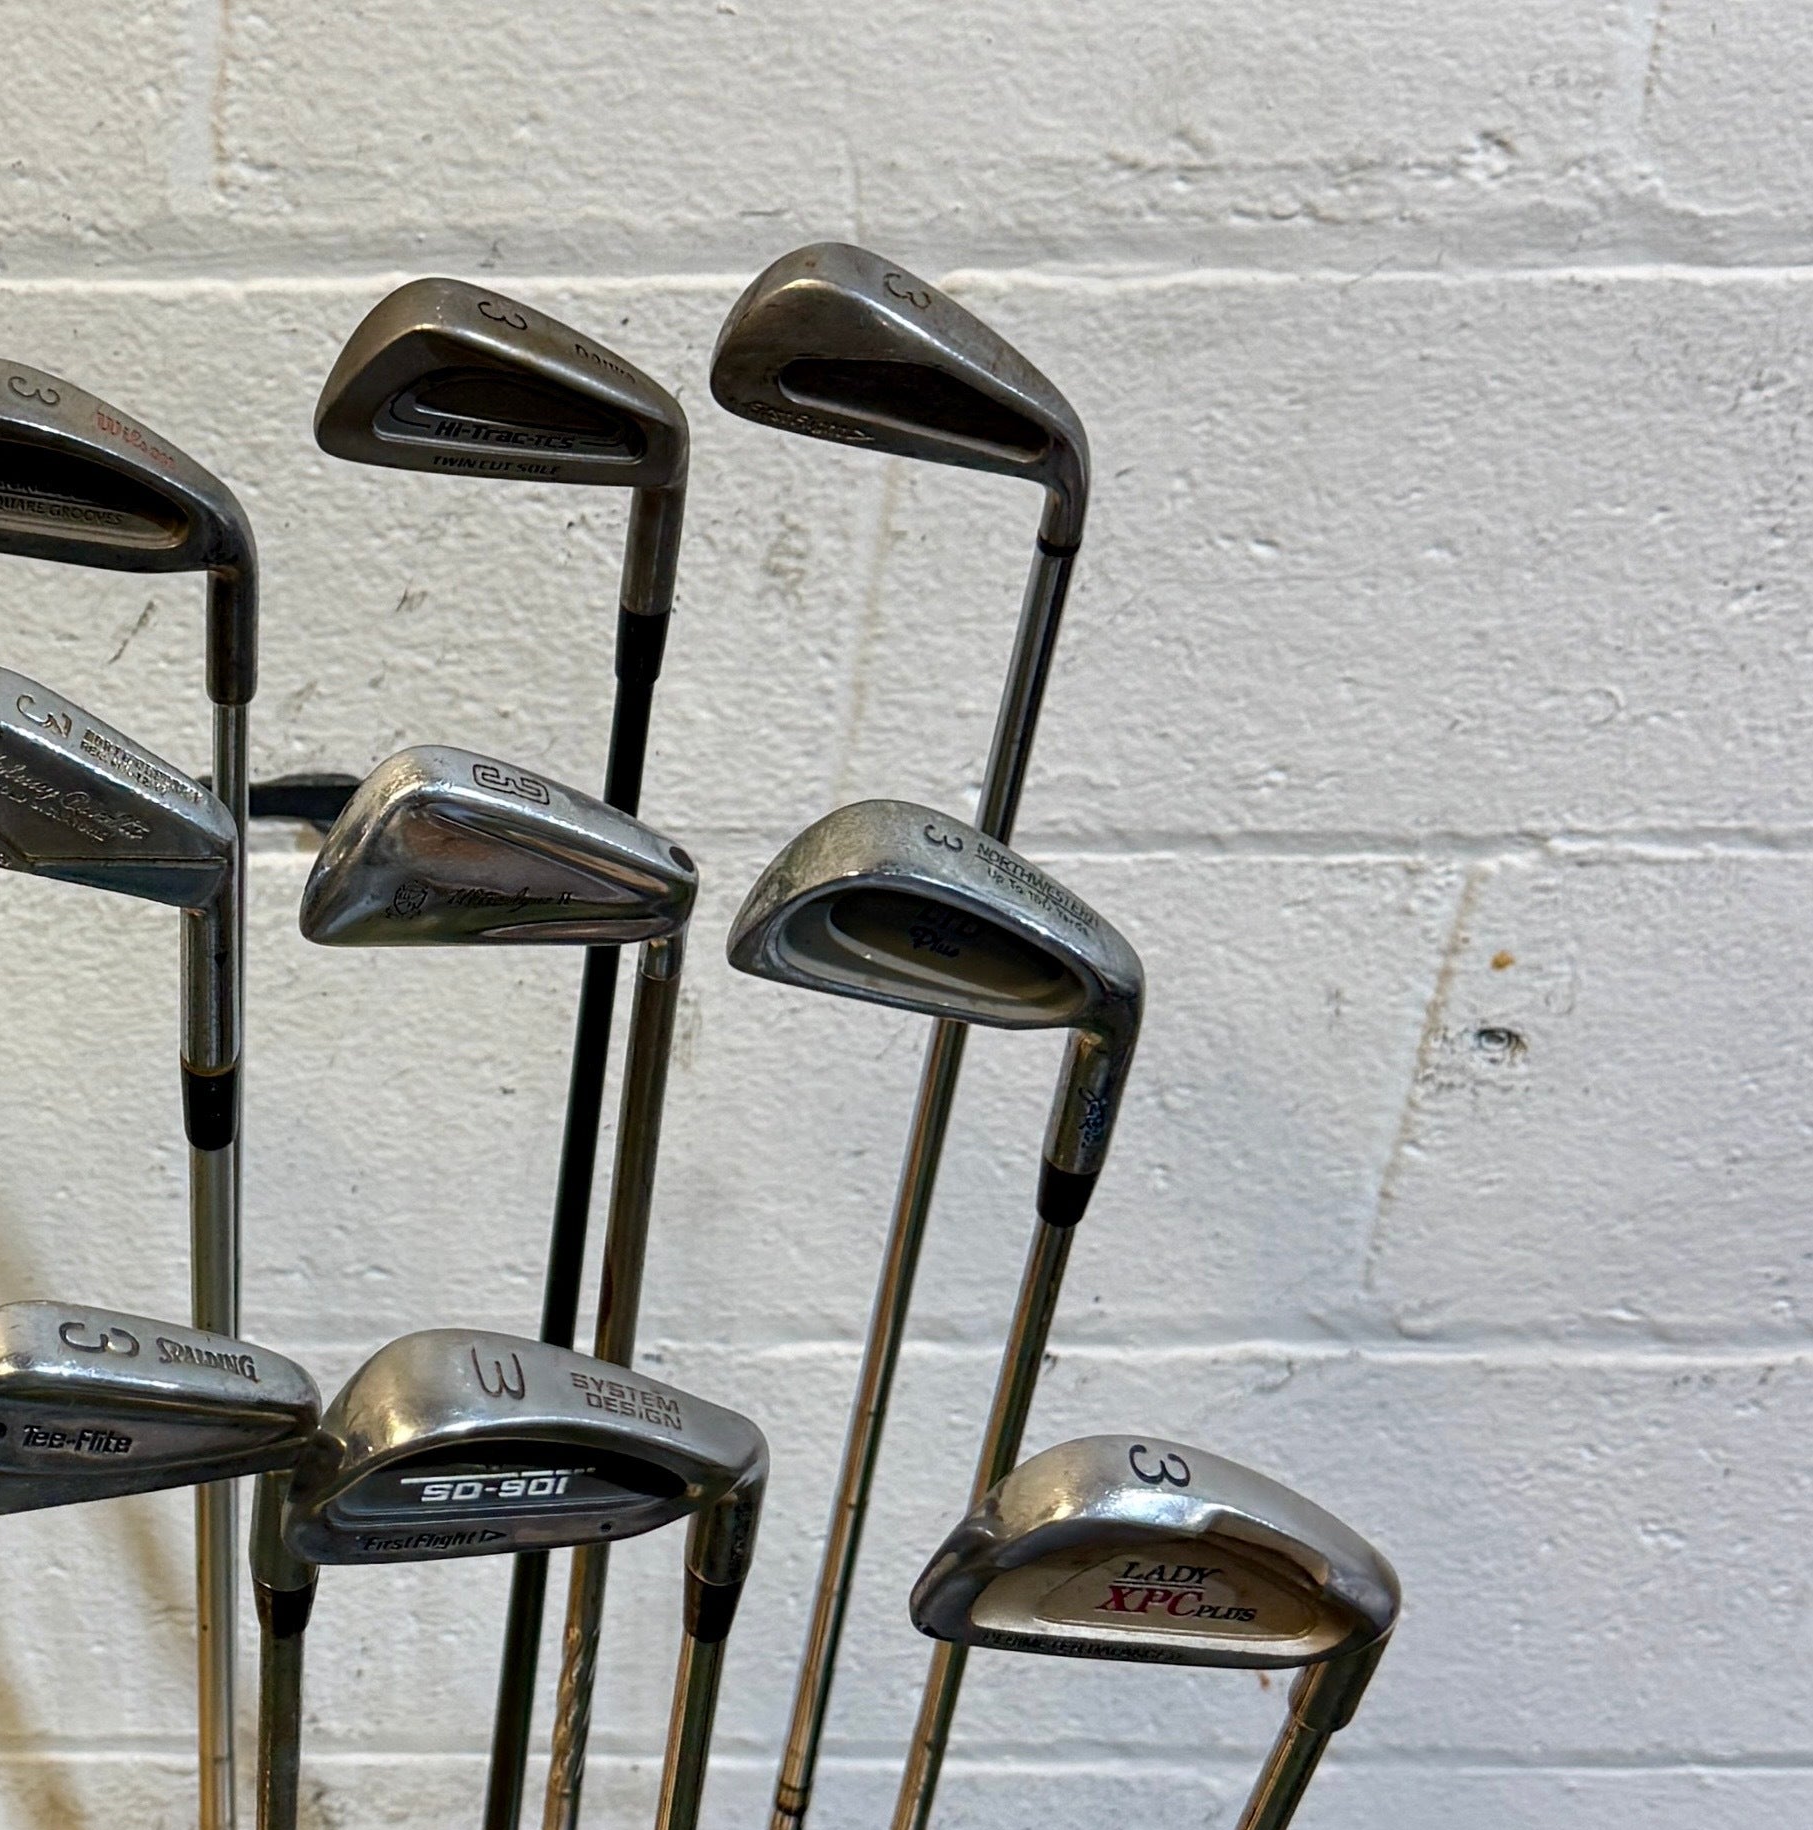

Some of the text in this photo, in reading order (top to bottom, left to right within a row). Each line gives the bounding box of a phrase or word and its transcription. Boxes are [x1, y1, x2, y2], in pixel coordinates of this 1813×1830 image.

[883, 272, 931, 310] 3
[477, 301, 528, 331] 3
[8, 375, 61, 406] 3
[94, 409, 176, 472] Wilson
[432, 454, 477, 470] TWIN
[49, 501, 123, 527] GROOVES
[17, 694, 72, 739] 3
[473, 764, 549, 805] 3
[923, 824, 963, 852] 3
[59, 1322, 140, 1357] 3
[156, 1336, 261, 1383] SPALDING
[471, 1346, 526, 1400] 3
[571, 1372, 680, 1415] SYSTEM
[587, 1392, 684, 1432] DESIGN
[22, 1424, 133, 1453] Tee-Flite
[1130, 1444, 1190, 1488] 3
[421, 1475, 569, 1502] SD-901
[1120, 1561, 1221, 1584] LADY
[1096, 1585, 1256, 1622] XPC PLUS
